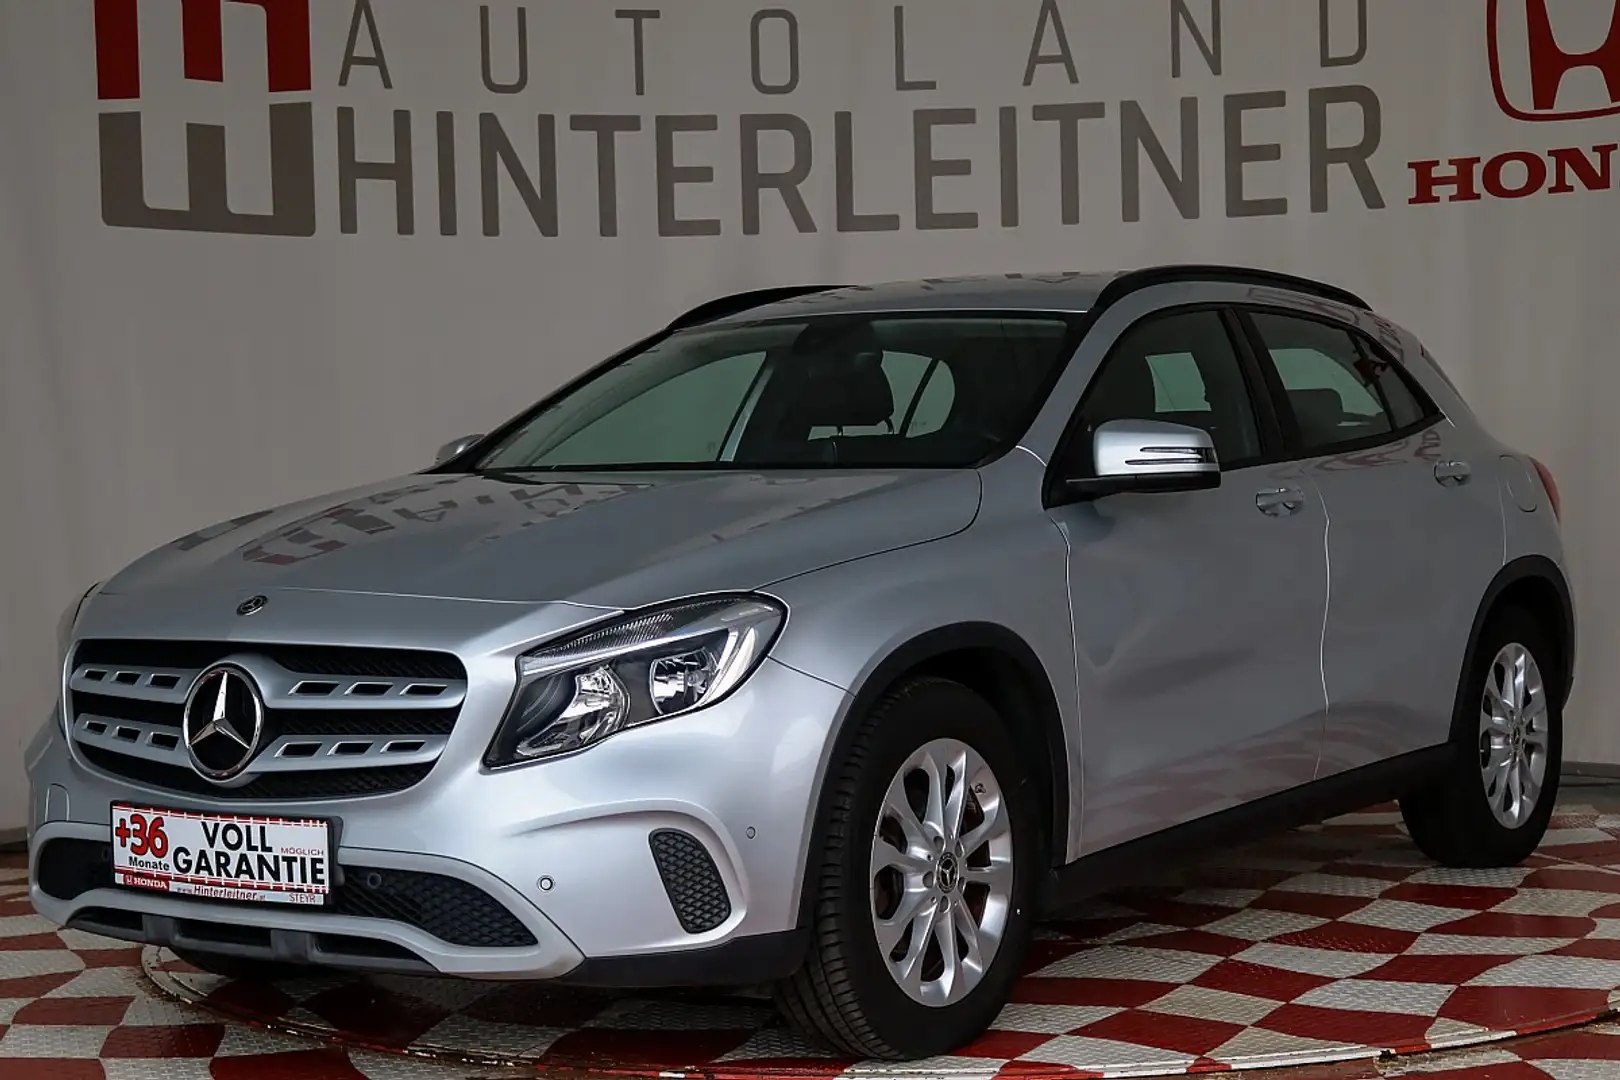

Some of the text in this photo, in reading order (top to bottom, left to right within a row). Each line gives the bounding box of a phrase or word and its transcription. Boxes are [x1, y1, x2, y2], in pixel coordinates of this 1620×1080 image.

[336, 85, 1386, 238] HINTERLEITNER
[115, 813, 169, 858] +36
[201, 821, 273, 853] VOLL
[128, 856, 170, 872] Monate
[172, 847, 325, 885] GARANTIE
[133, 877, 168, 889] HONDA
